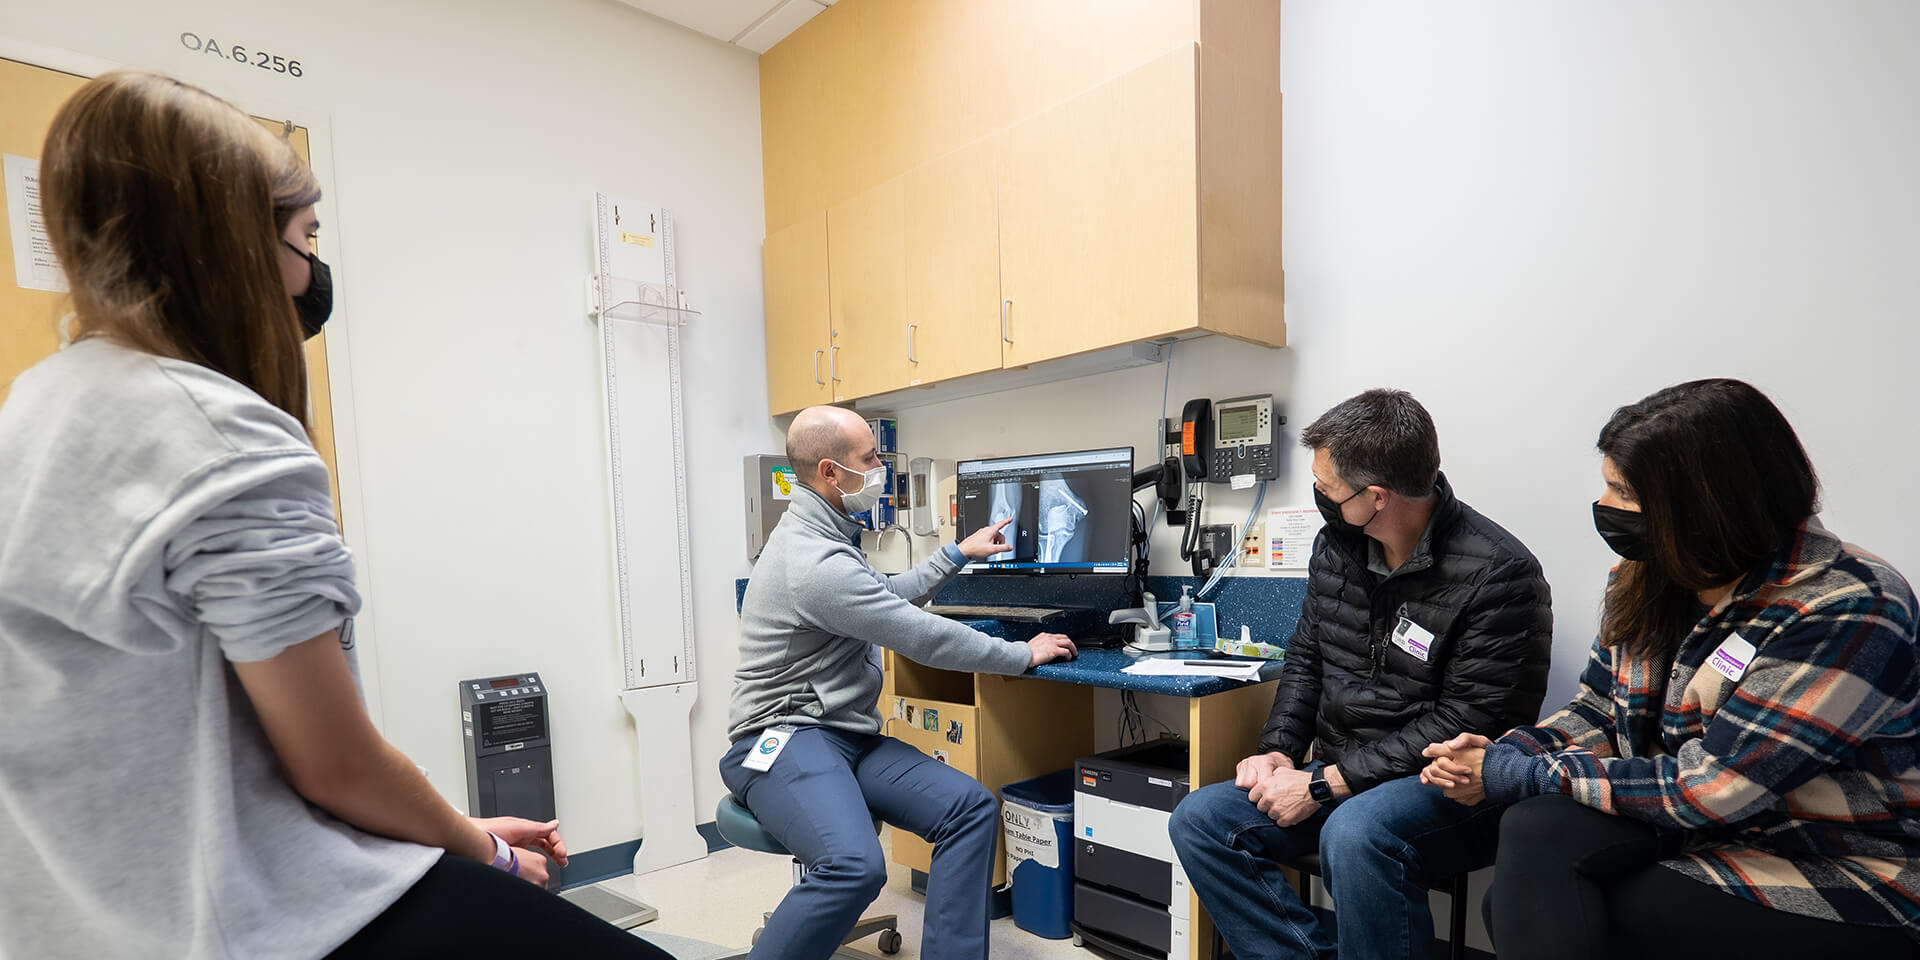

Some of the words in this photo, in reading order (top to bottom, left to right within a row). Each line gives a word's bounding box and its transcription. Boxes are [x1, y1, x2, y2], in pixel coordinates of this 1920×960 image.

[180, 32, 303, 77] OA.6.256
[1711, 656, 1735, 676] Clinic
[1005, 810, 1030, 827] ONLY
[1015, 830, 1031, 841] Table
[1032, 835, 1052, 847] Paper
